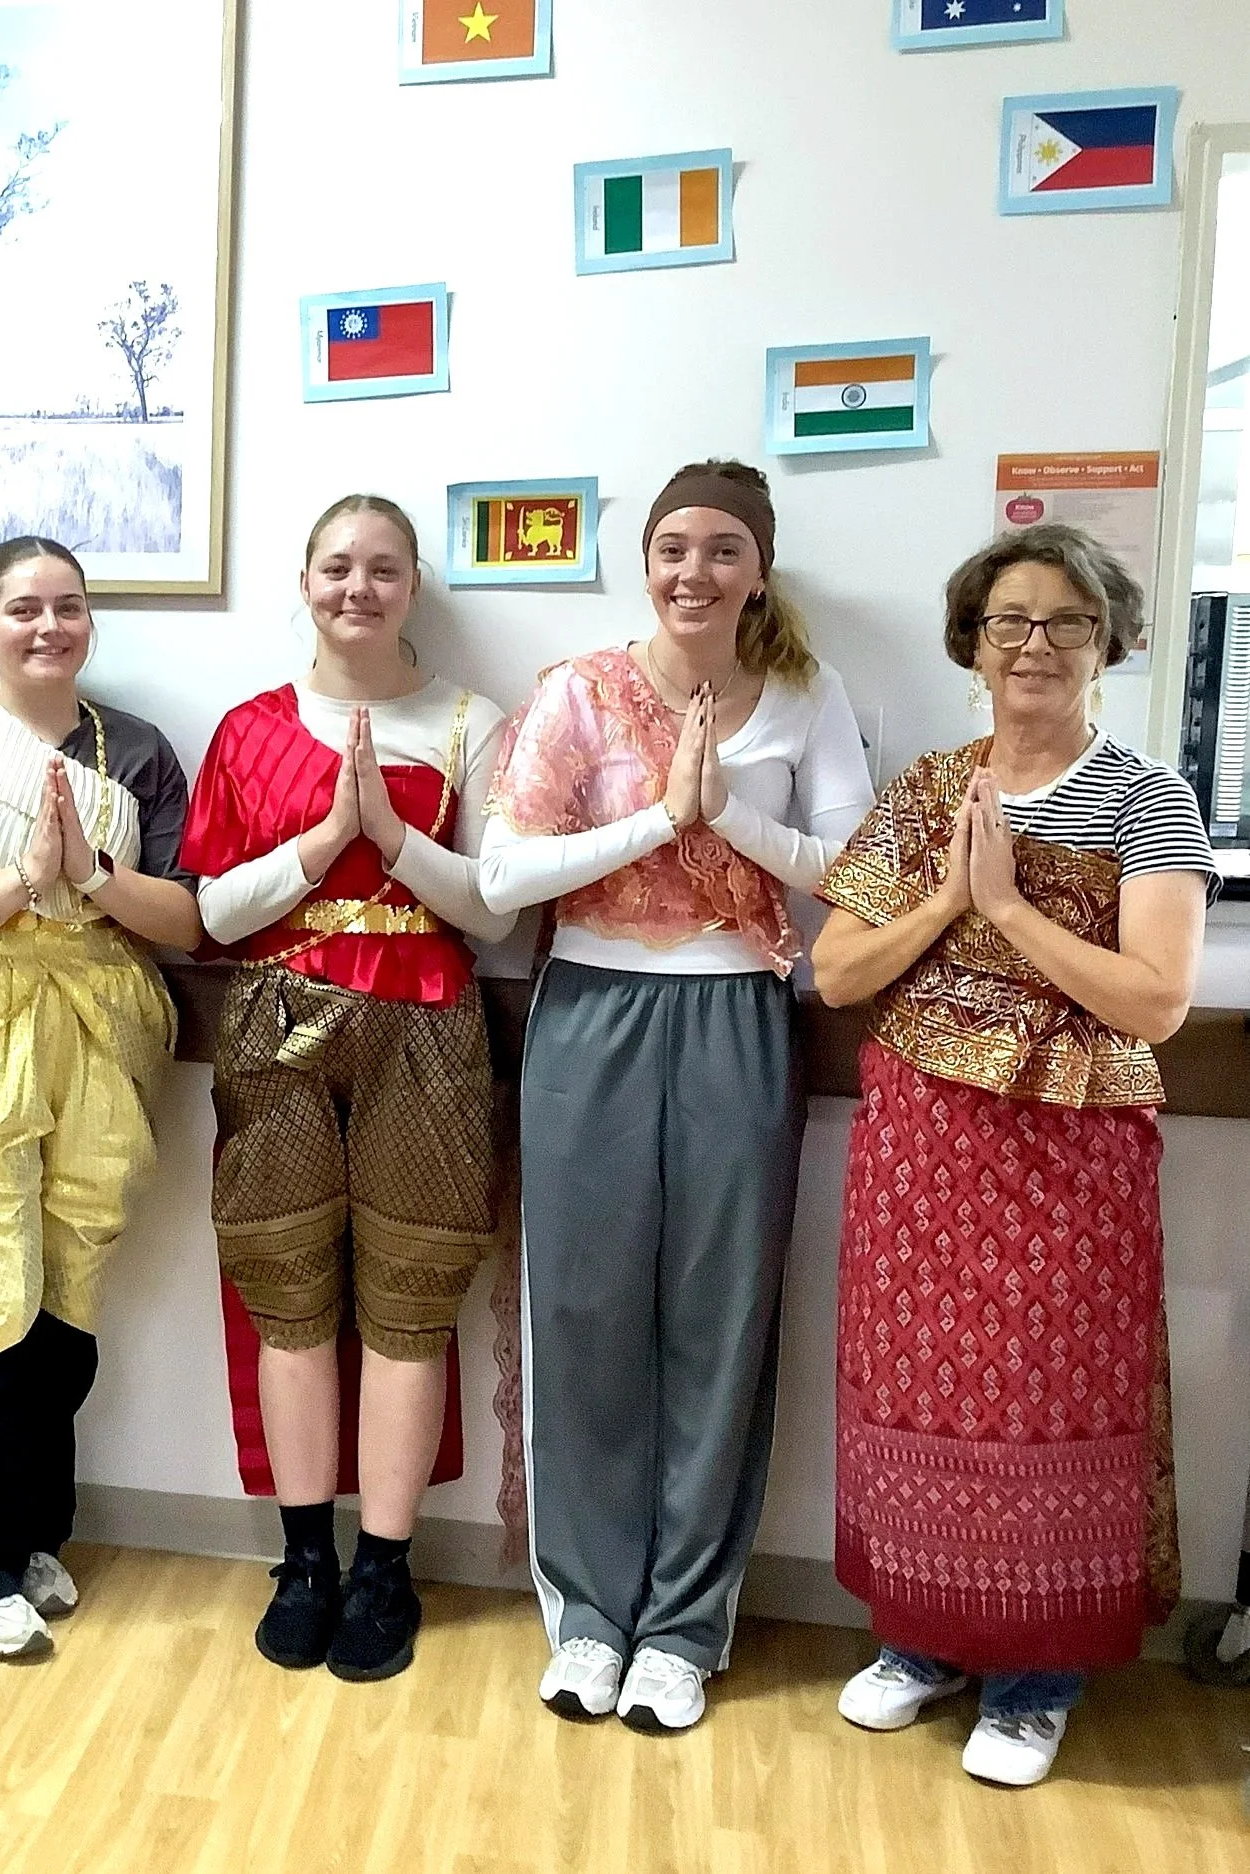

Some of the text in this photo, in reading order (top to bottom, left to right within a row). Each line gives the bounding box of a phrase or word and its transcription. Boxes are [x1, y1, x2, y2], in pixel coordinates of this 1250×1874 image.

[1011, 464, 1145, 476] Know Observe Support Act
